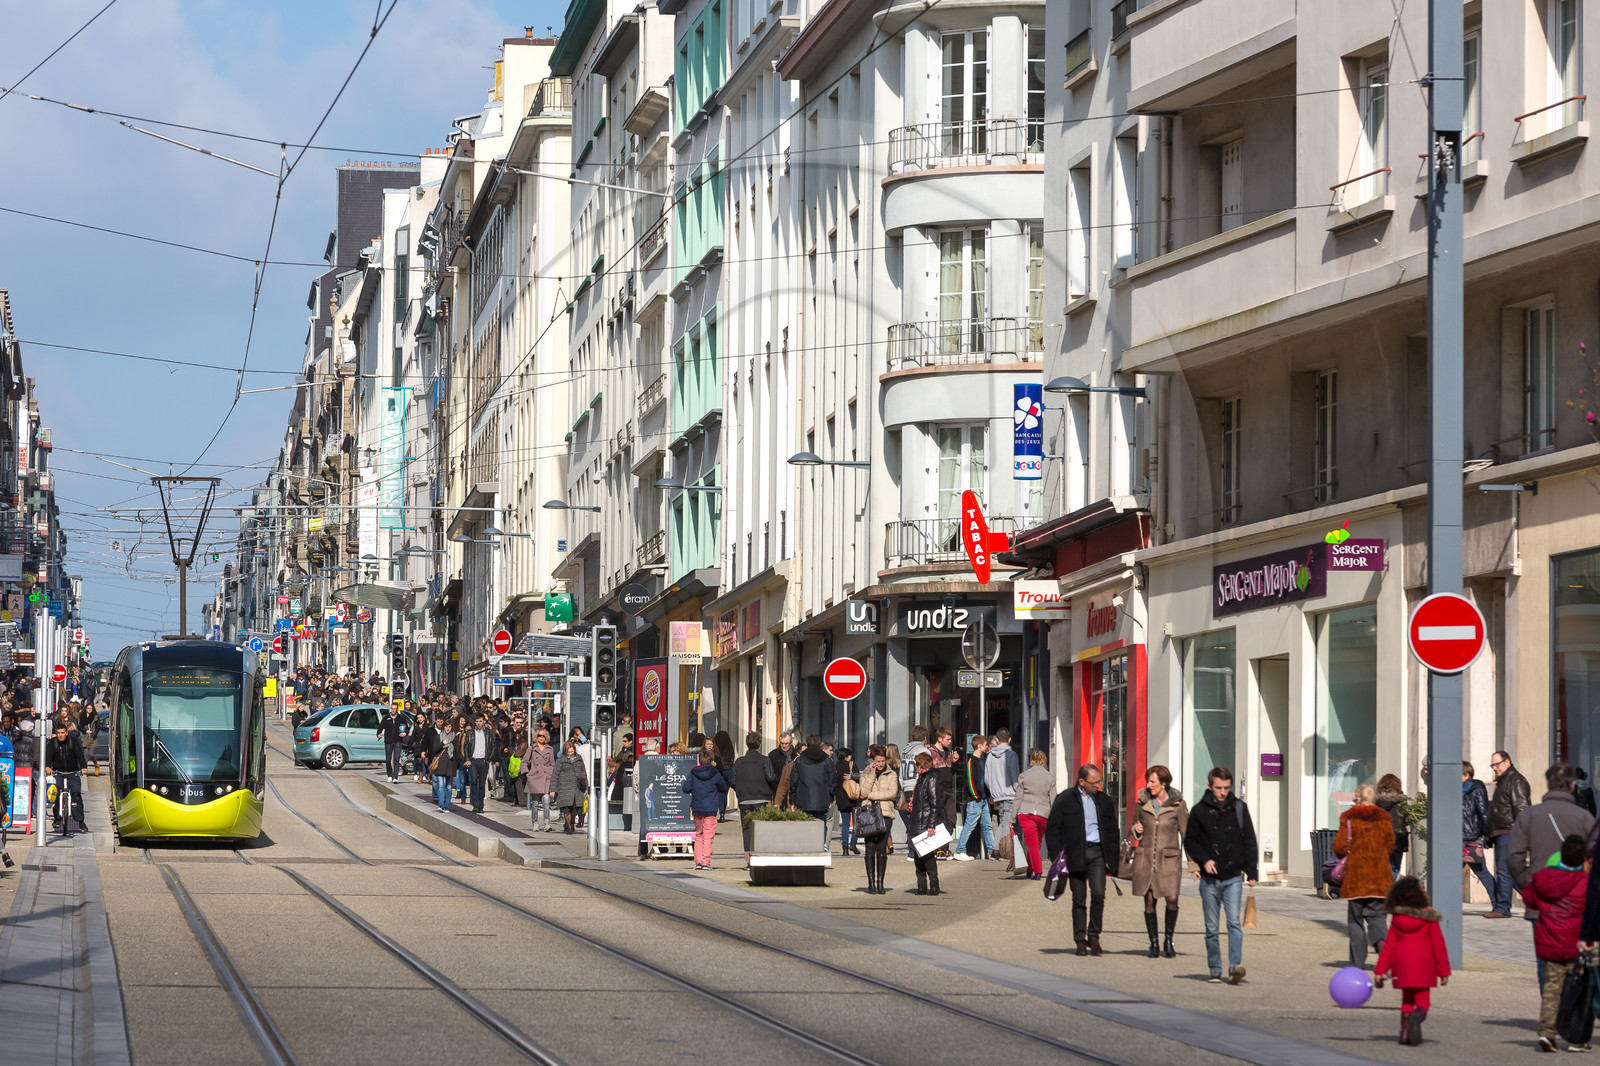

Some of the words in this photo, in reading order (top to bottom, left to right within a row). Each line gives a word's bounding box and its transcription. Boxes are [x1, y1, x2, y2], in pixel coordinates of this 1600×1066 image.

[383, 404, 400, 516] PRINTEMPS
[1014, 461, 1042, 470] LOTO
[966, 508, 986, 566] TABAC
[624, 593, 650, 604] éram
[907, 604, 969, 630] undiz
[850, 622, 877, 632] undiz
[645, 677, 658, 690] BURGER
[645, 684, 659, 701] KING
[644, 720, 652, 730] 100
[666, 774, 687, 782] SPA
[179, 788, 204, 797] bibus
